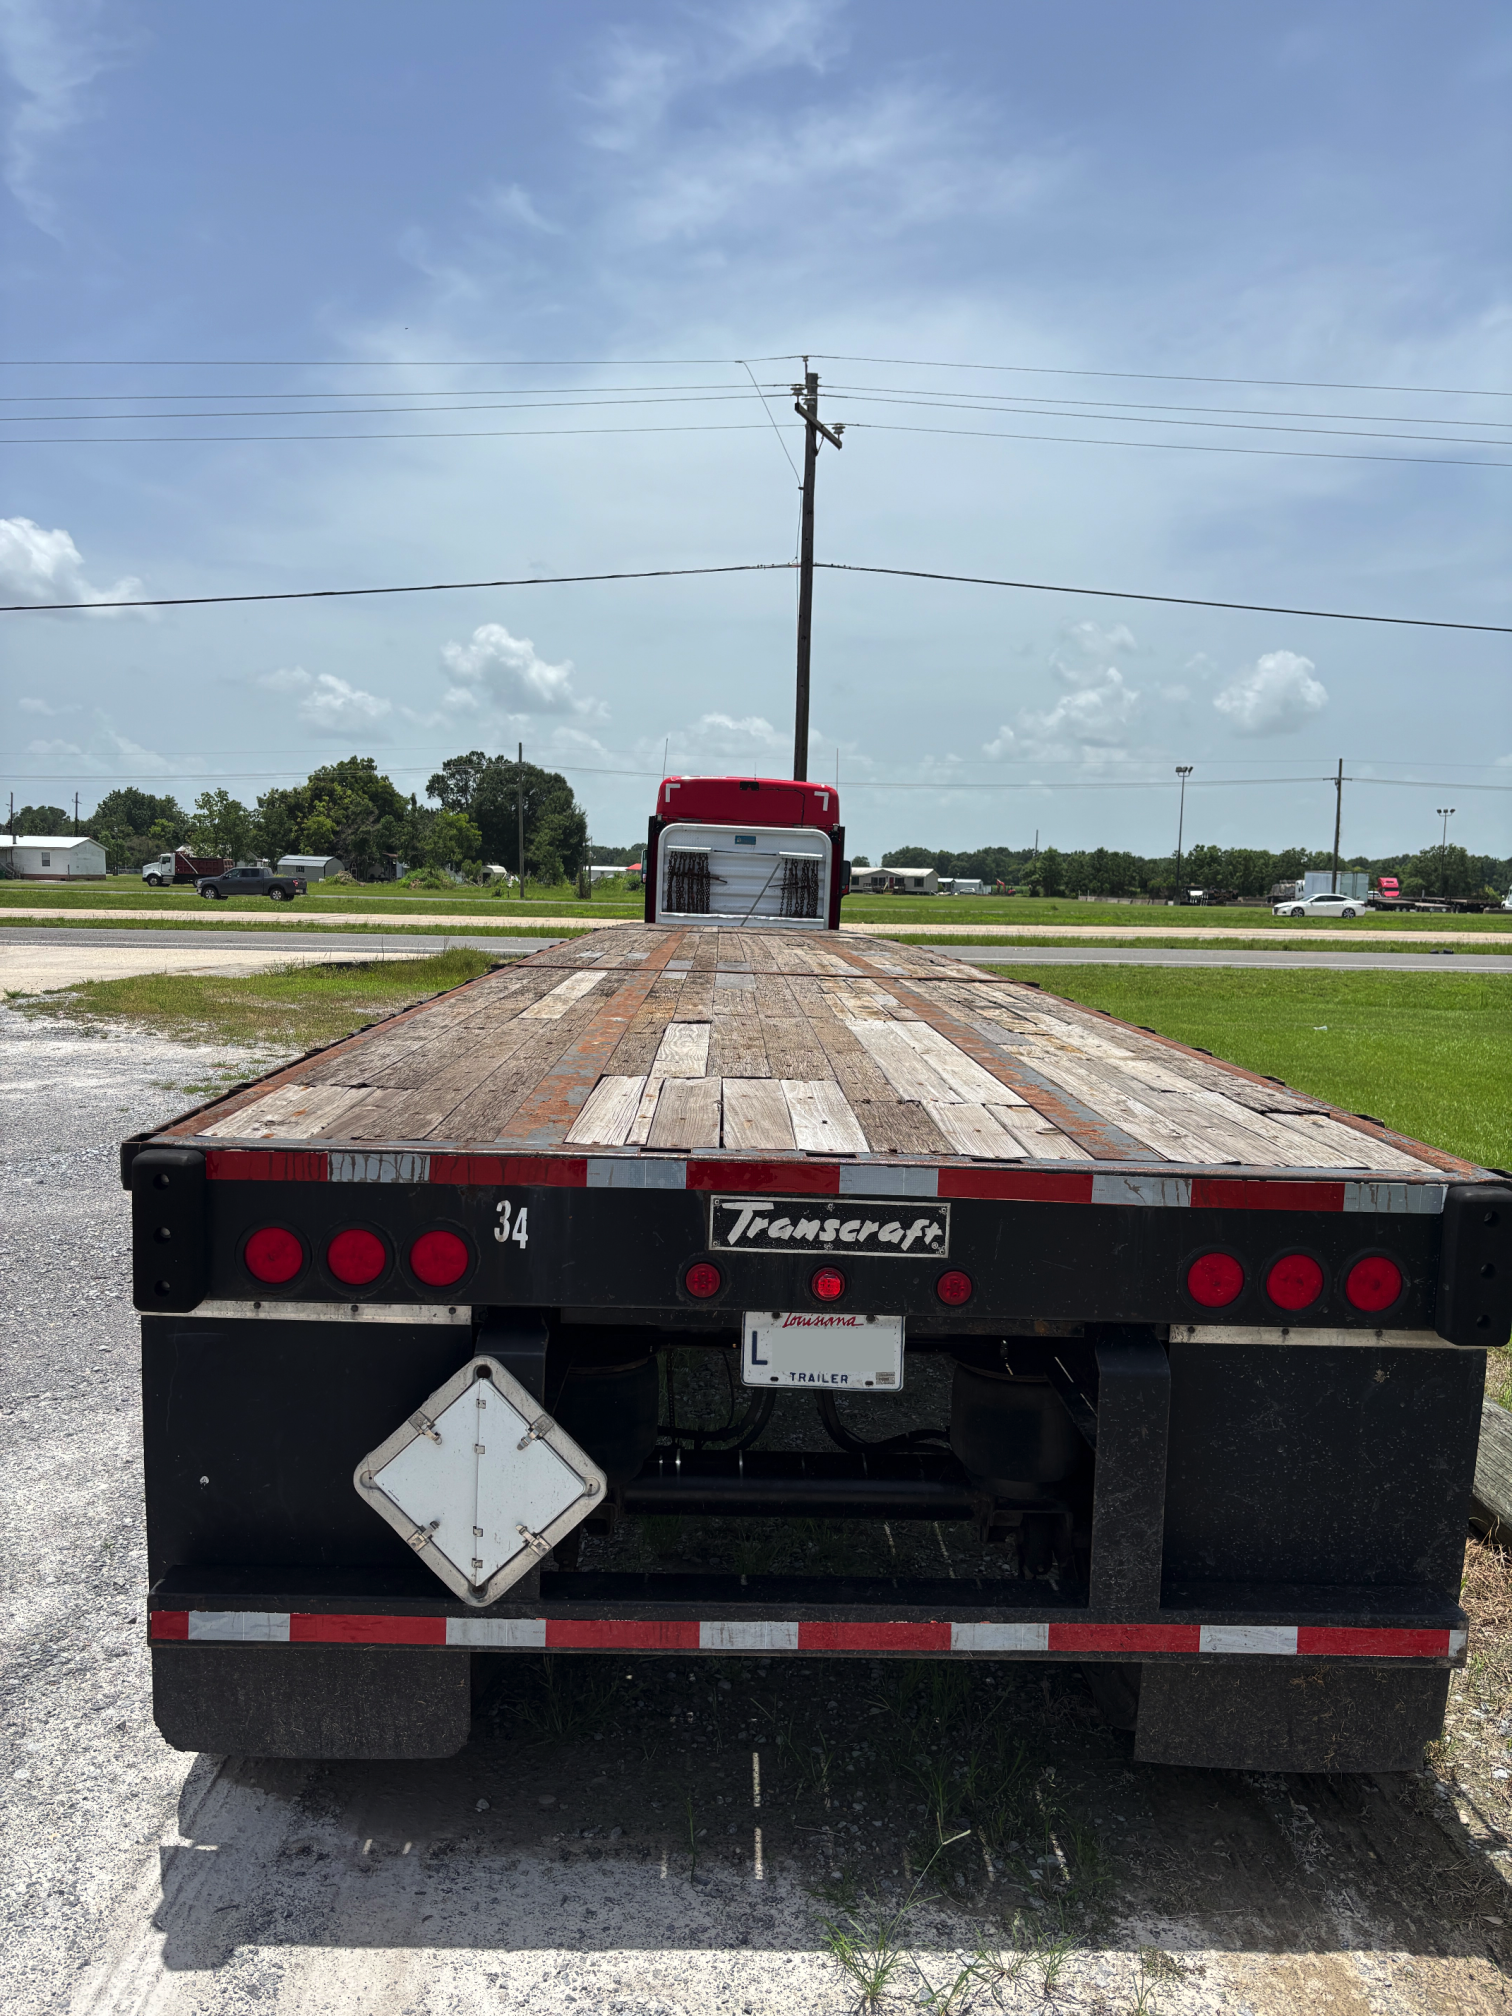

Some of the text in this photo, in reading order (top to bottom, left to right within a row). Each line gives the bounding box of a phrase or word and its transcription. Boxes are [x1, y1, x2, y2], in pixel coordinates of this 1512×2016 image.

[494, 1200, 529, 1250] 34
[721, 1202, 943, 1251] Transcraft
[782, 1312, 864, 1328] Louisiana
[789, 1372, 849, 1384] TRAILER
